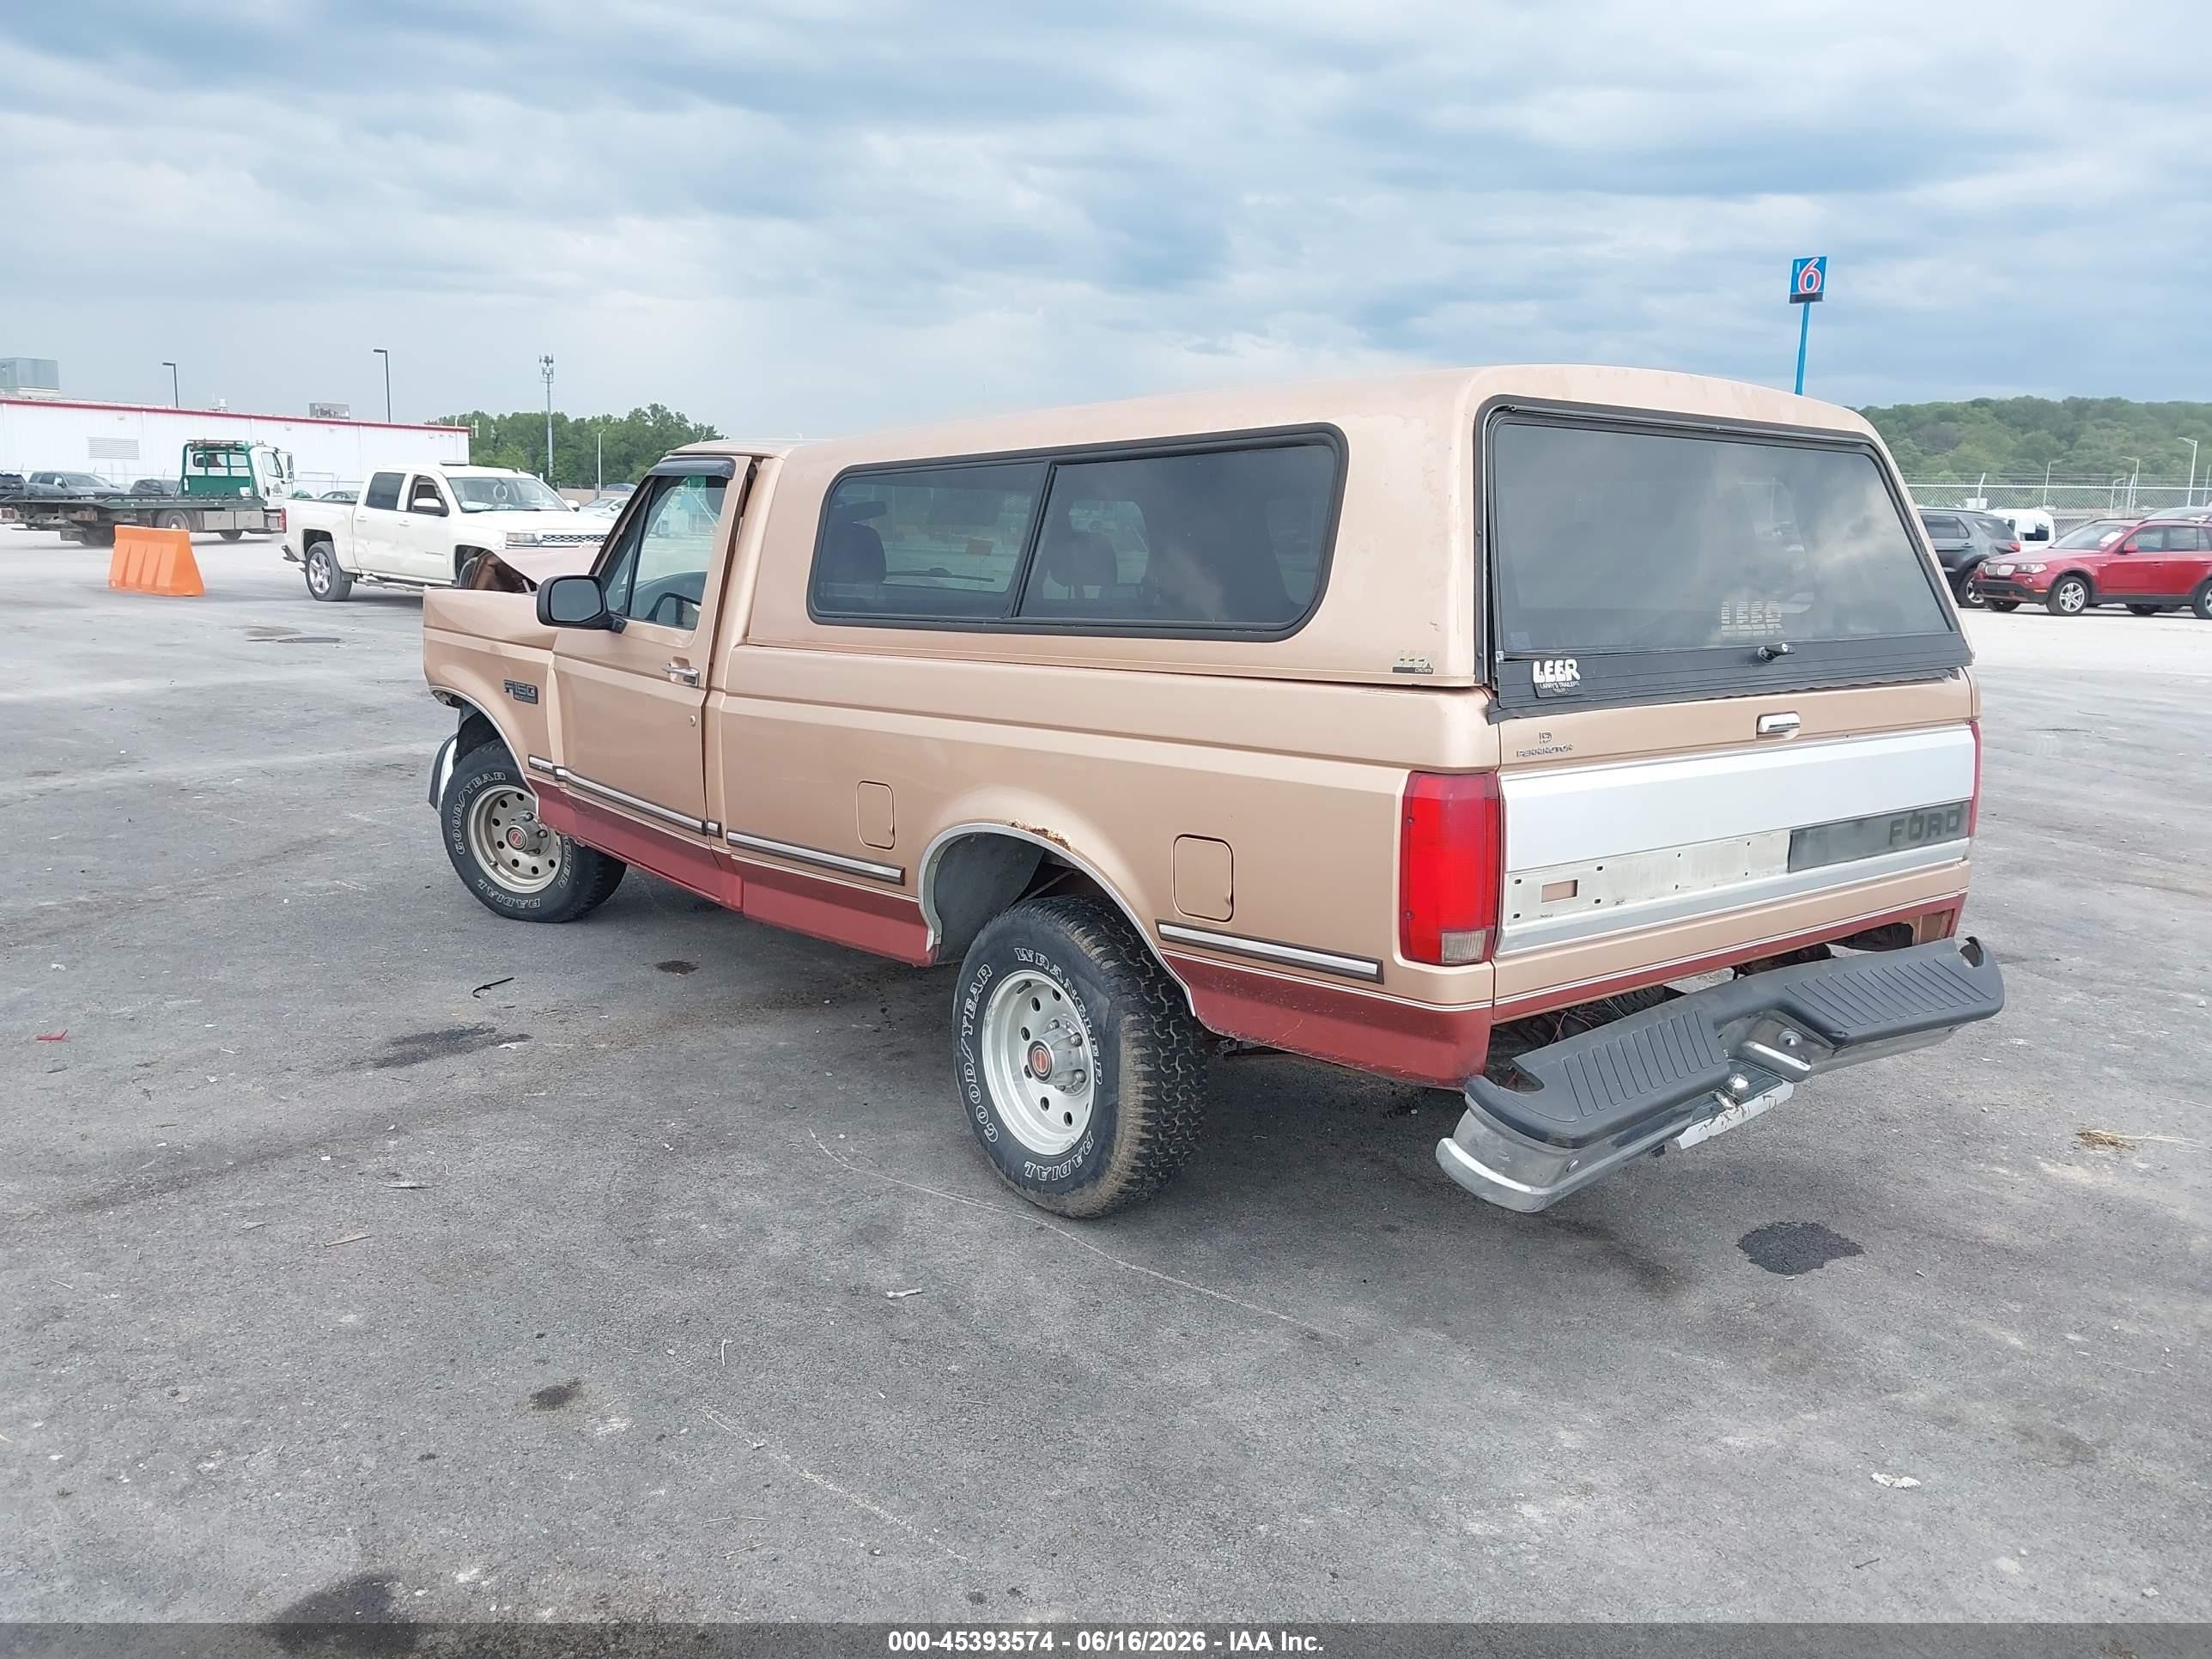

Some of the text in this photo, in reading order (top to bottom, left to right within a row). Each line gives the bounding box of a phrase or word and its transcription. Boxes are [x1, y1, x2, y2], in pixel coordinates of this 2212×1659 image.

[1798, 258, 1821, 294] 6
[1720, 600, 1786, 635] LEER
[1533, 659, 1581, 684] LEER
[1516, 744, 1573, 757] PENNINGTON
[1889, 809, 1960, 845] FORD
[477, 878, 541, 908] RADIAL
[1014, 947, 1103, 1085] WRANGLER
[1024, 1129, 1095, 1182] RADIAL
